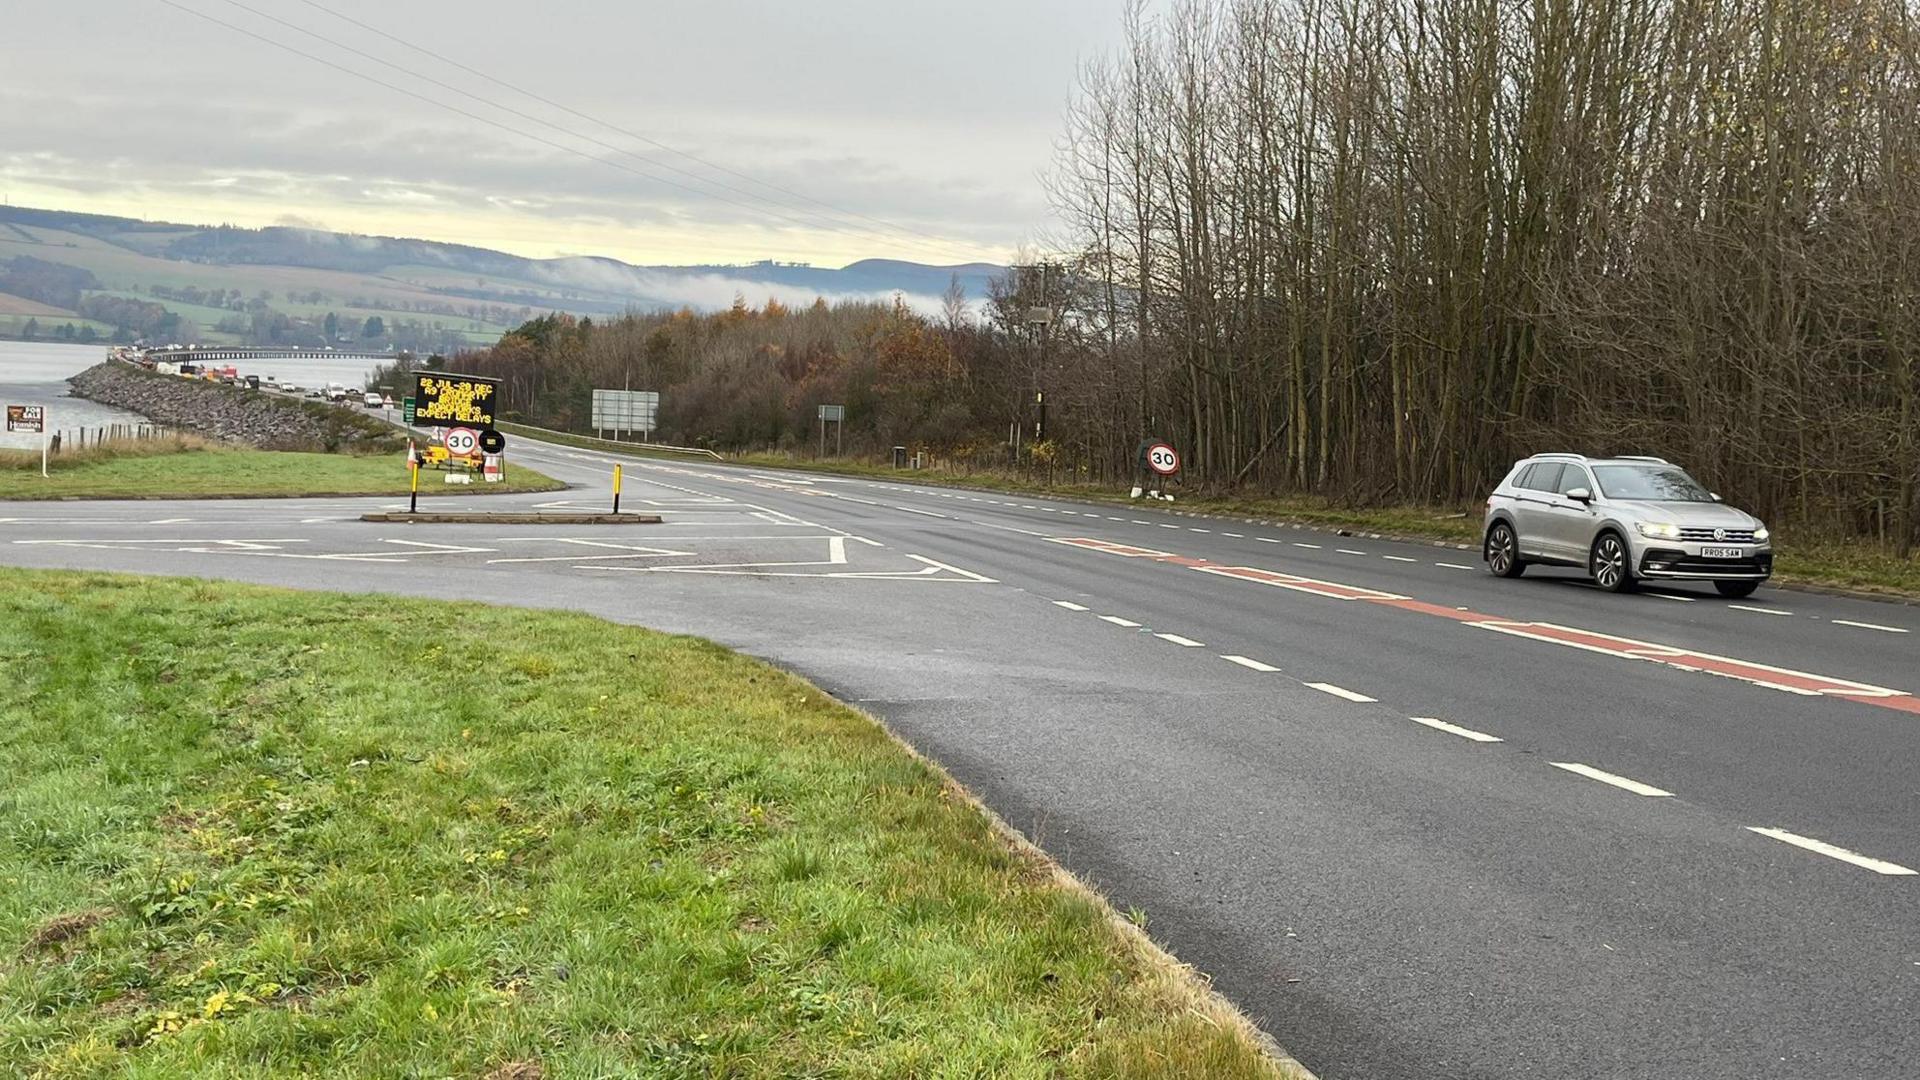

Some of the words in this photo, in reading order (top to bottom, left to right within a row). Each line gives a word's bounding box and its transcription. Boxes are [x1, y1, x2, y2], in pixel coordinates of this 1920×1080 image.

[420, 378, 432, 387] 22
[474, 384, 492, 394] DEC
[424, 387, 436, 396] A9
[440, 388, 488, 400] CROMARTY
[438, 394, 472, 406] BRIDGE
[428, 402, 481, 414] ROADWORKS
[416, 408, 453, 419] EXPECT
[456, 412, 492, 424] DELAYS
[449, 436, 473, 448] 30
[1152, 452, 1174, 466] 30
